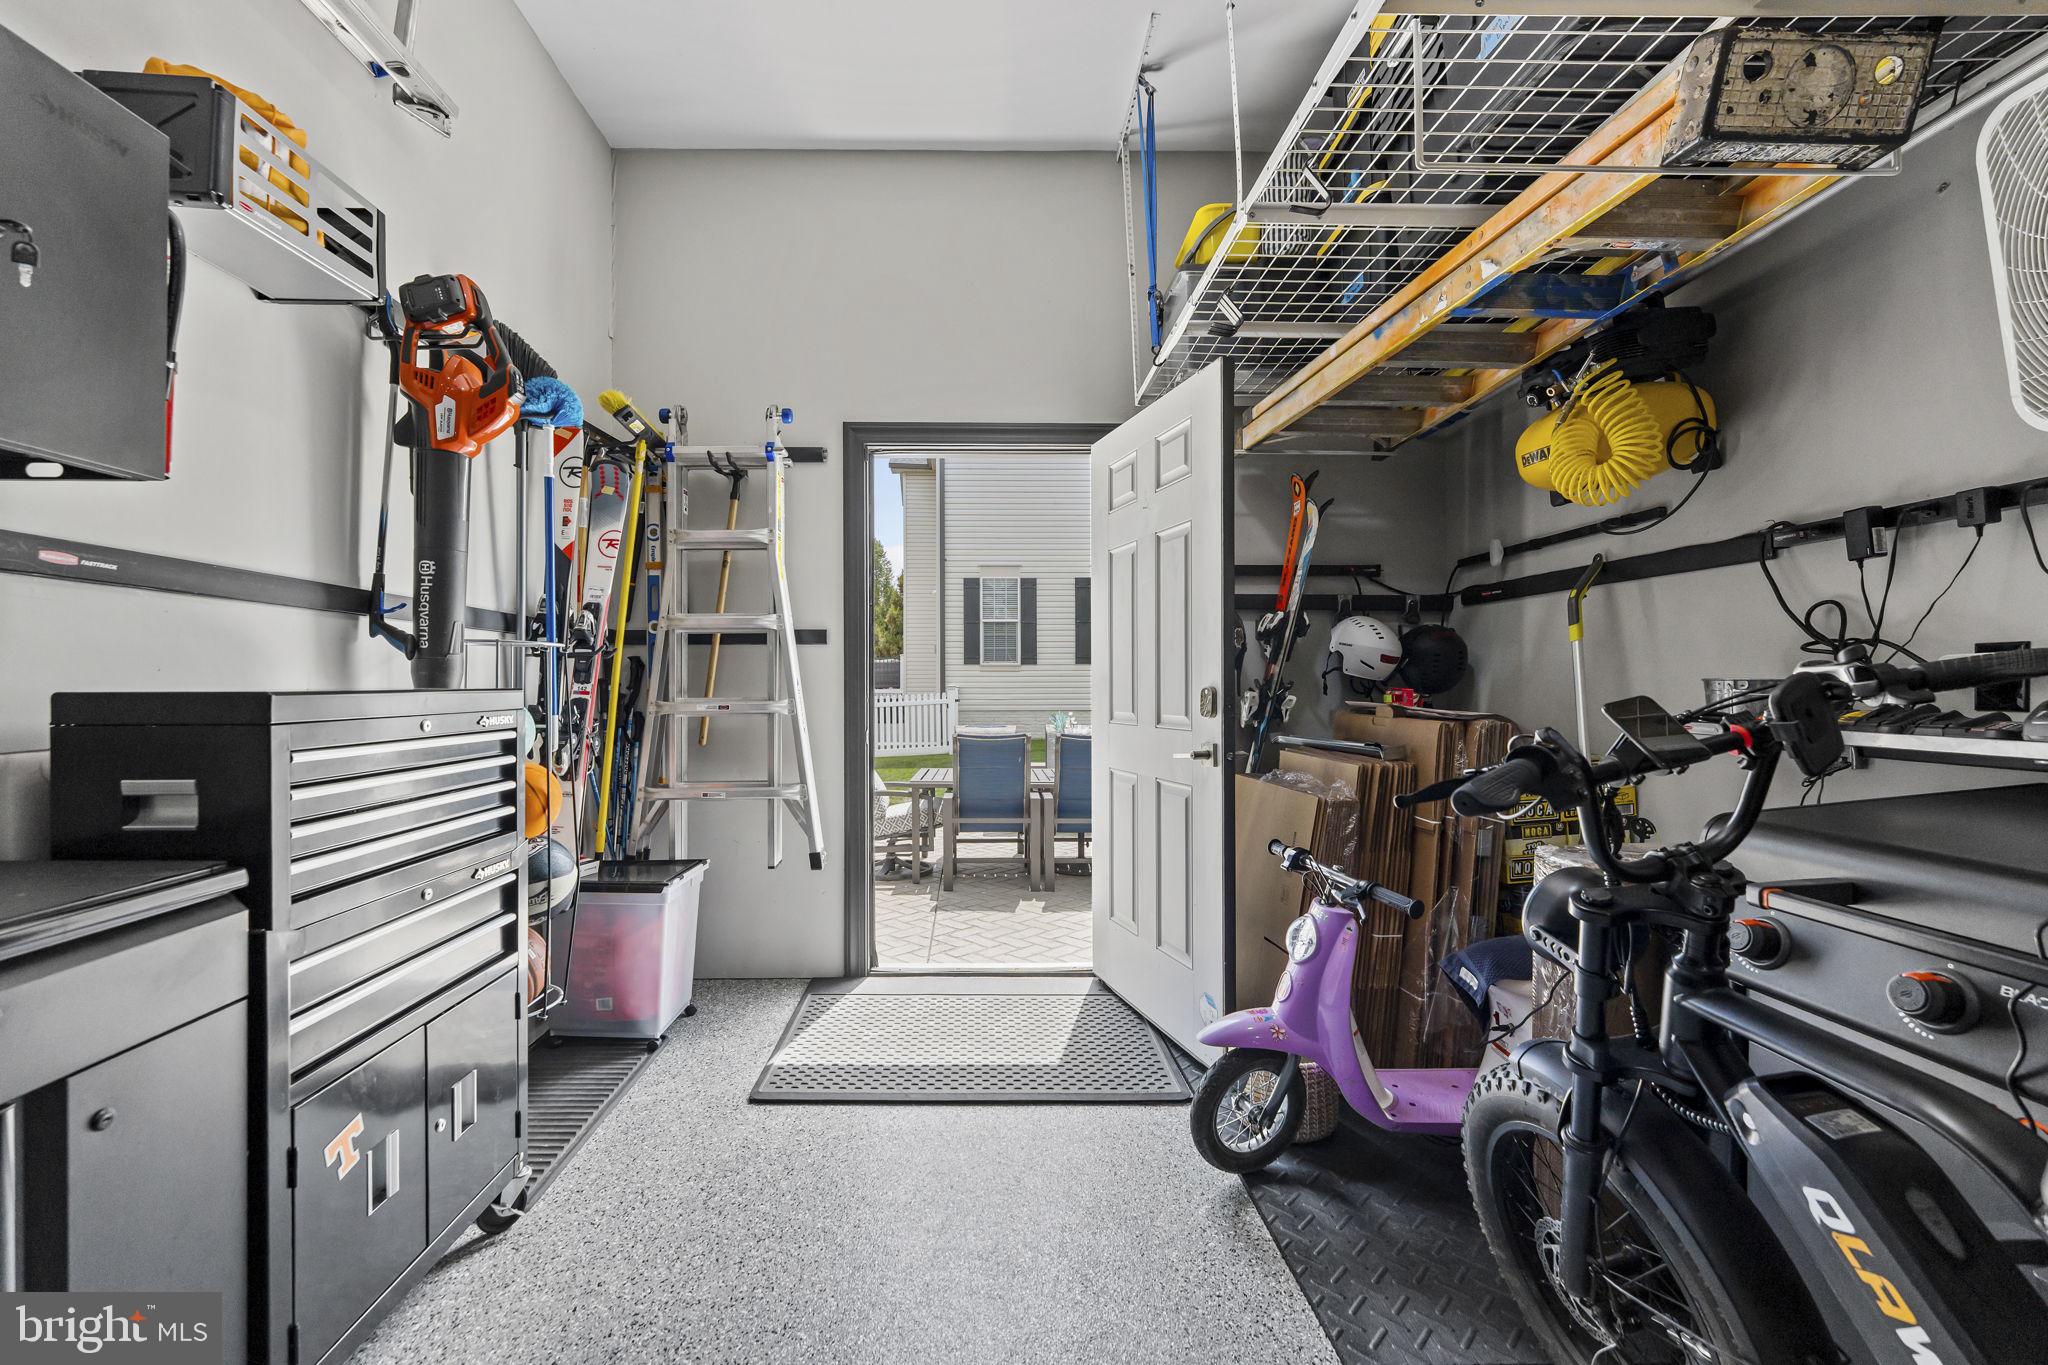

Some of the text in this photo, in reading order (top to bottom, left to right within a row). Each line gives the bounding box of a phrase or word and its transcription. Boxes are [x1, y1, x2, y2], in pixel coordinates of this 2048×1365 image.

[419, 575, 433, 649] Husqvarna
[489, 715, 514, 726] HUSKY
[484, 858, 510, 877] HUSKY
[1514, 861, 1532, 875] NO
[323, 1111, 365, 1181] T
